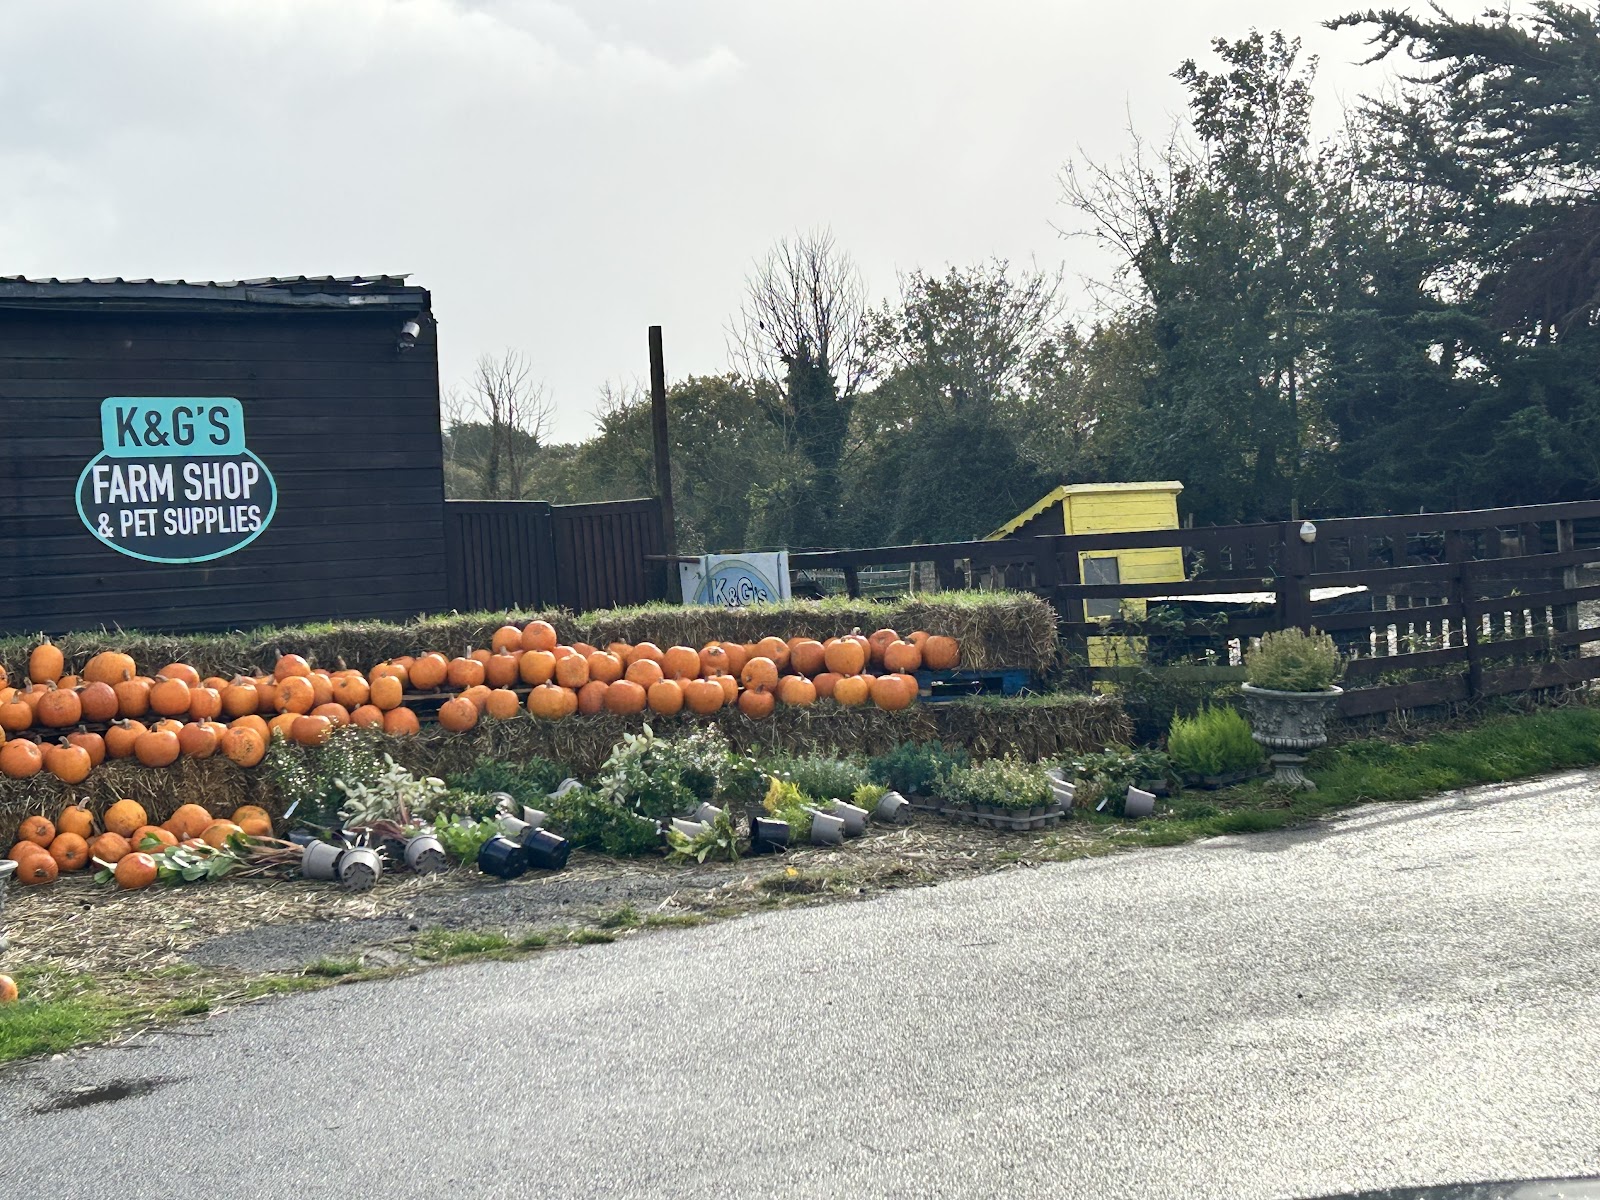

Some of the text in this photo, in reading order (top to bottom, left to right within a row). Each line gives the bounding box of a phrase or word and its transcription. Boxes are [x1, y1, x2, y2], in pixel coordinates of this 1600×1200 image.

[116, 406, 231, 447] K&G'S
[92, 461, 259, 504] FARM SHOP
[97, 505, 262, 538] & PET SUPPLIES
